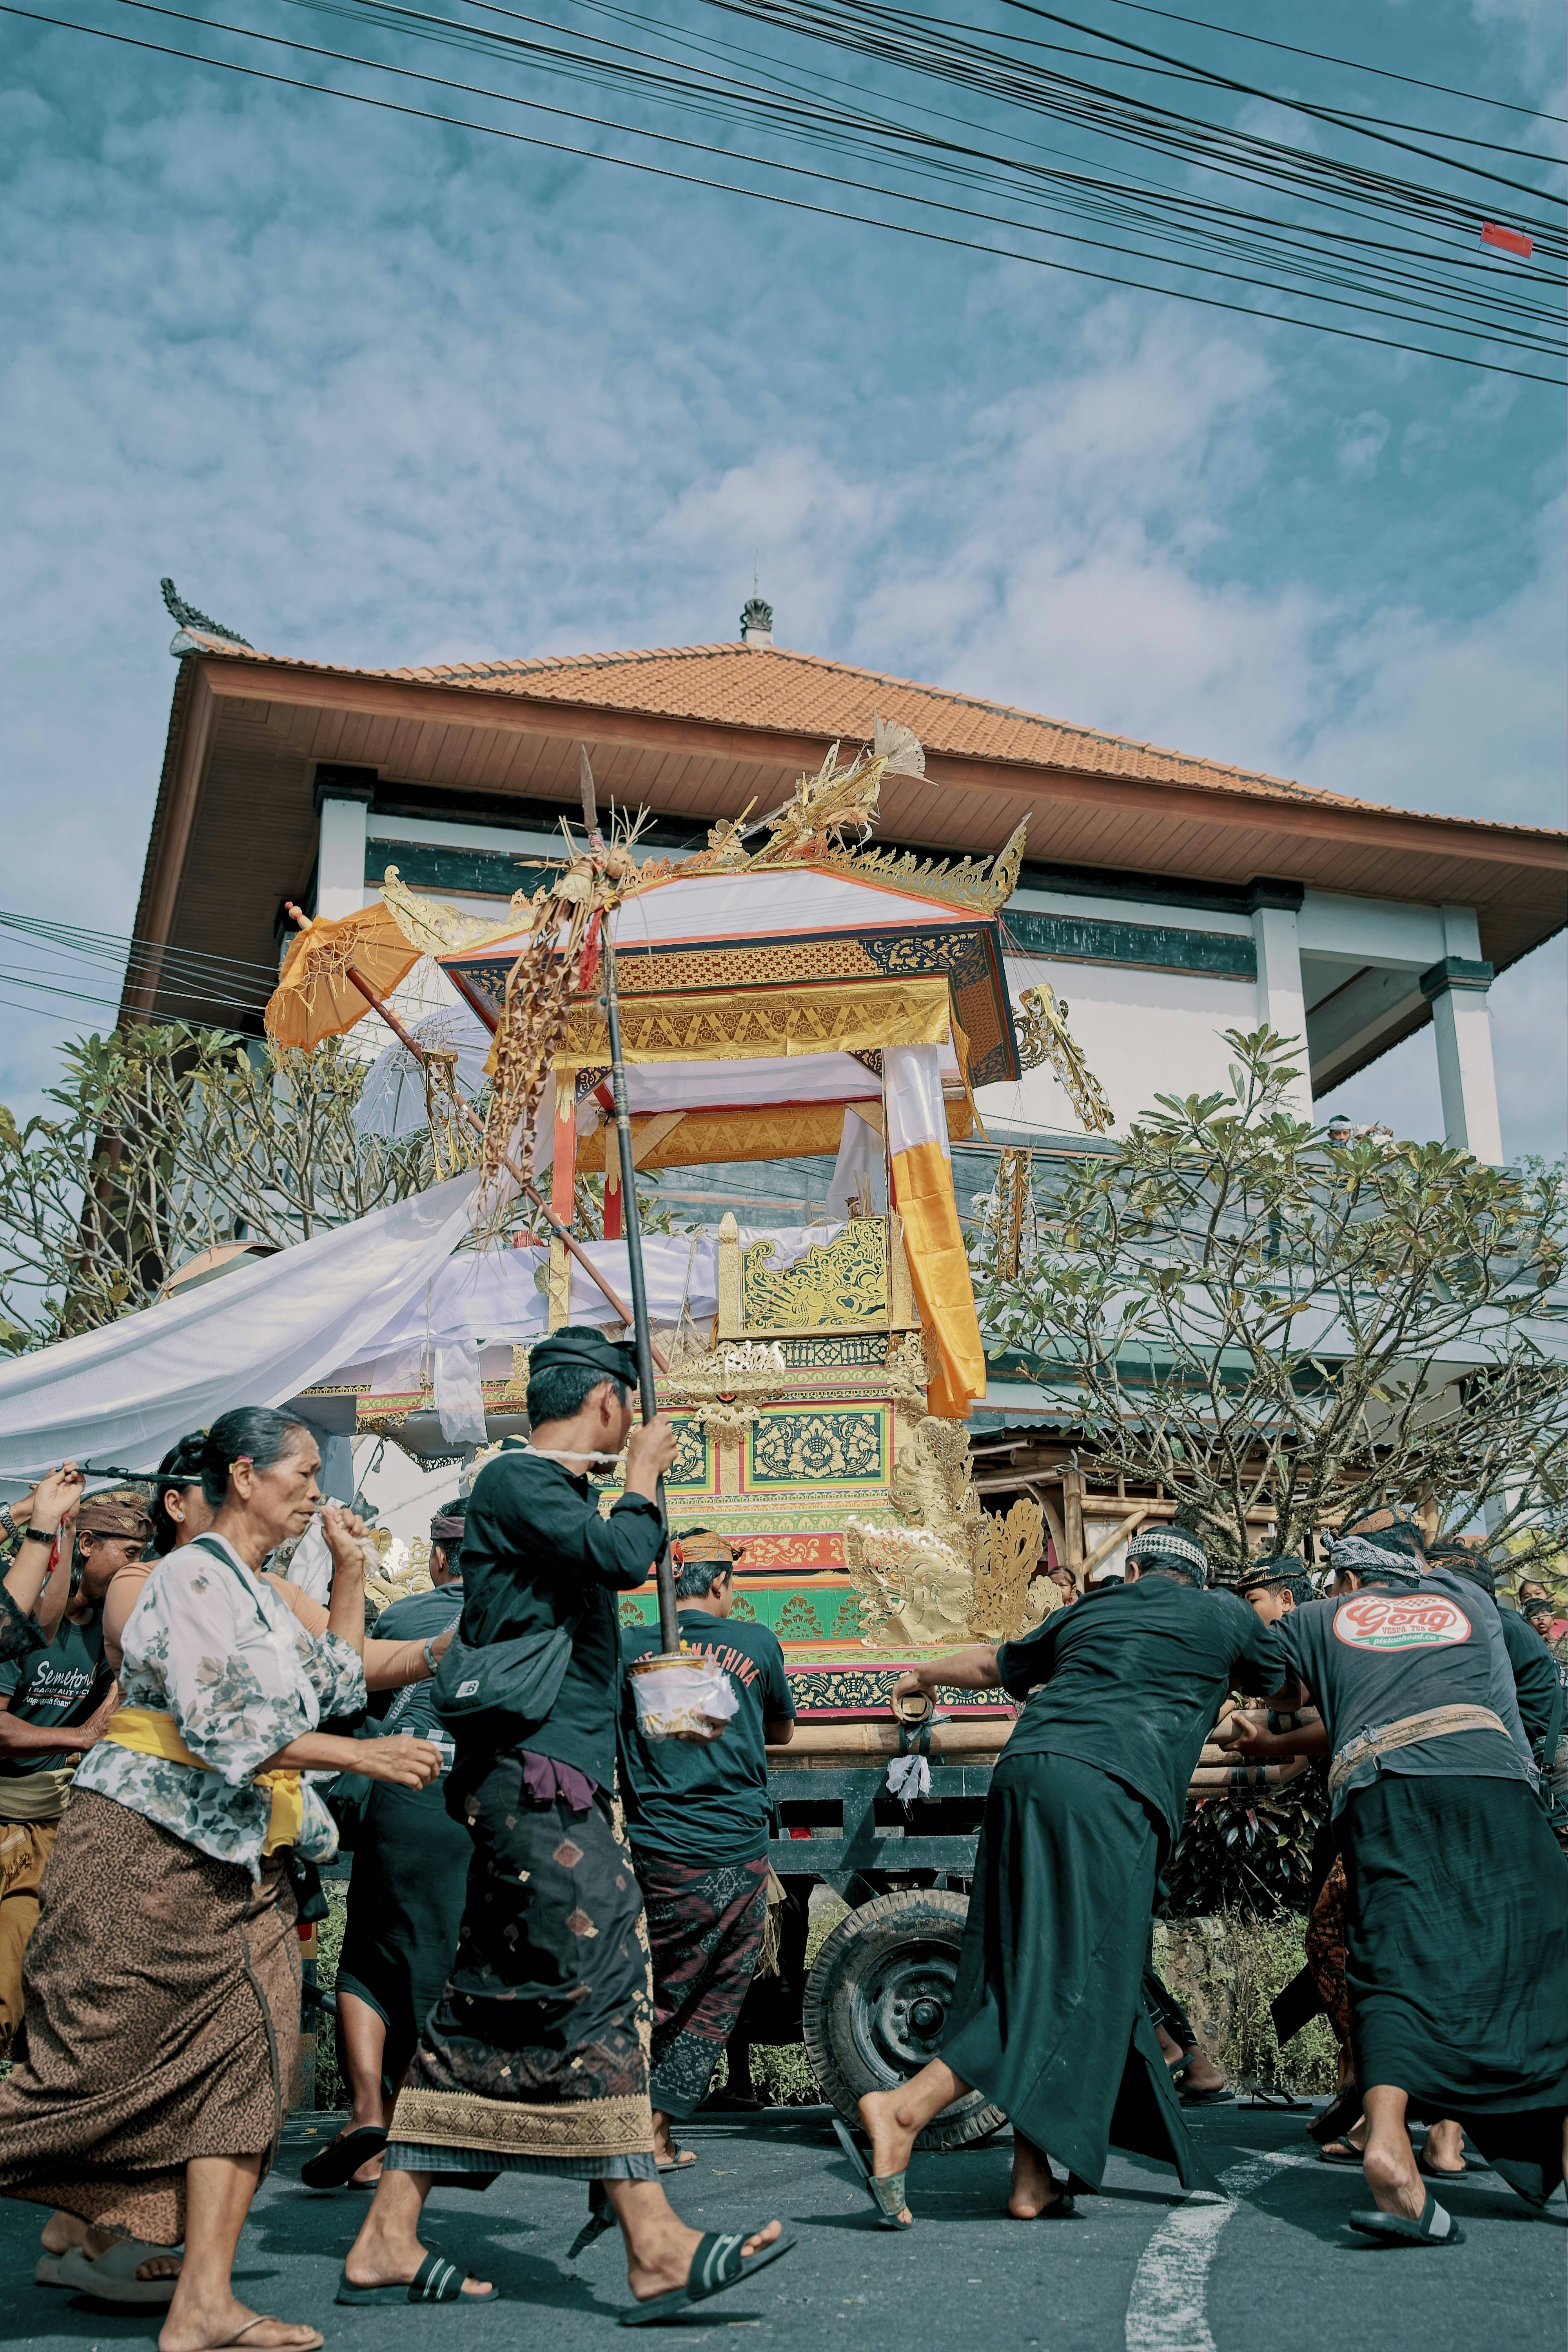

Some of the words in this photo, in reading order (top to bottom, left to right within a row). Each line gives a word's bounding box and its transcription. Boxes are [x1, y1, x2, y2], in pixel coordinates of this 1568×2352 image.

[1346, 1603, 1457, 1636] Geng
[1382, 1626, 1406, 1634] VESPA
[1373, 1633, 1436, 1645] pistonhead.co
[389, 1682, 417, 1720] ayhem
